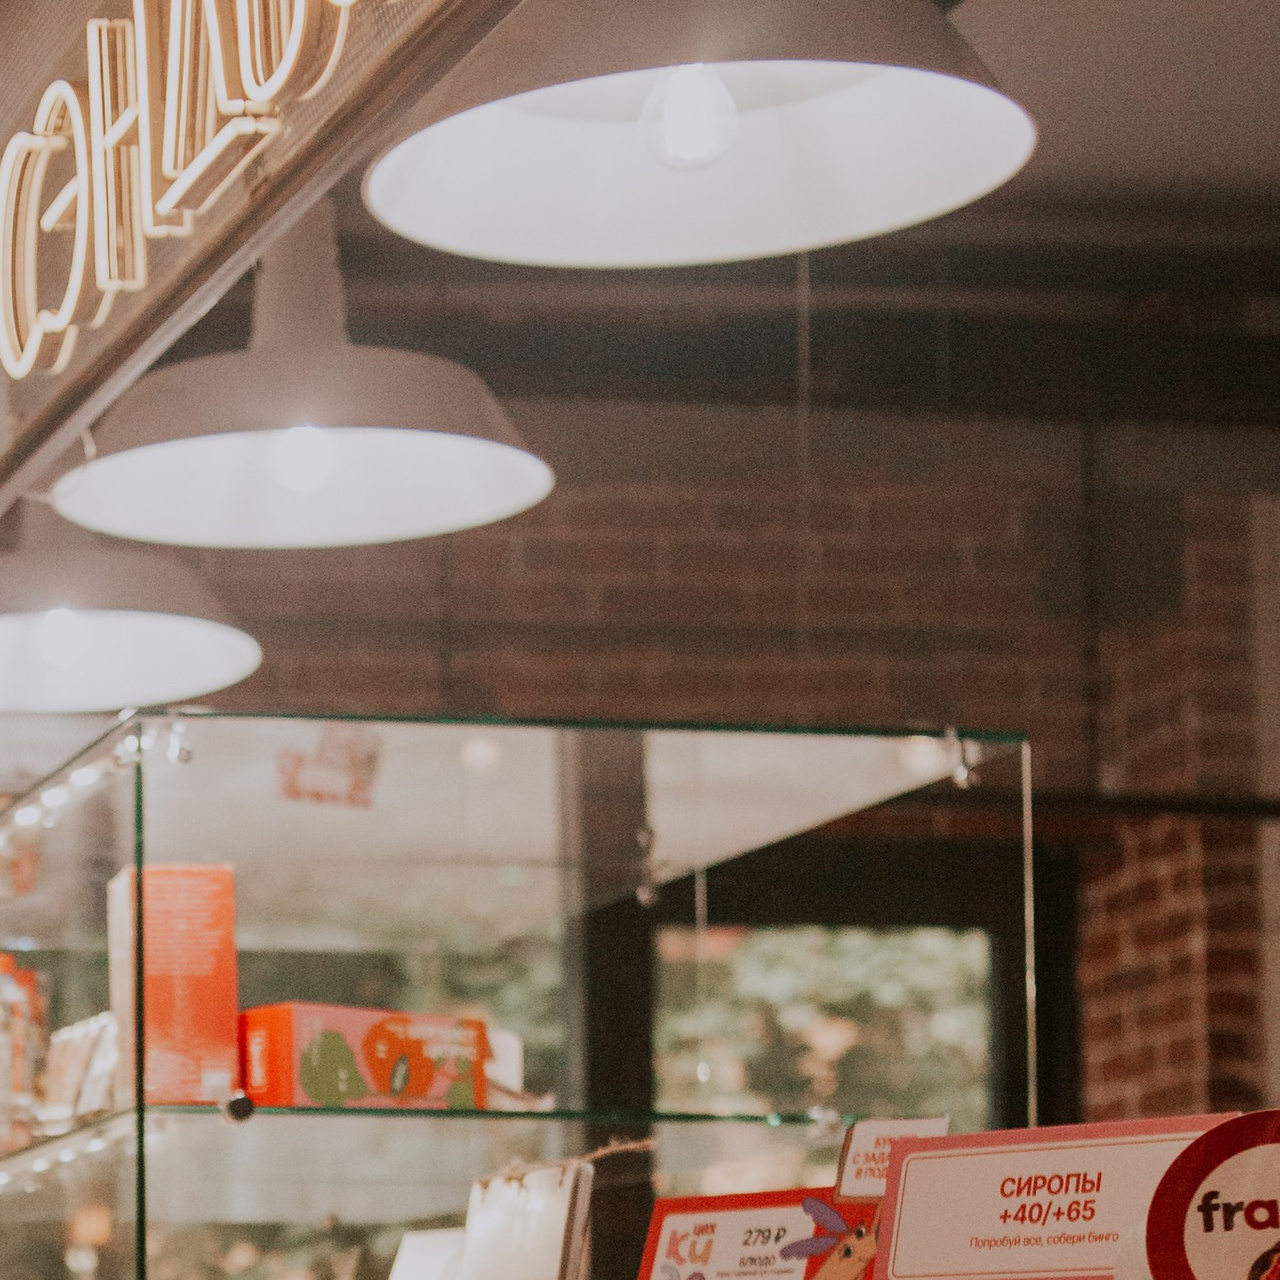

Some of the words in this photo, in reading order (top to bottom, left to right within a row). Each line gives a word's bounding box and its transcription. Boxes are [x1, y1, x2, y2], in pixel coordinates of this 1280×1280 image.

[1000, 1172, 1102, 1198] СИРОПЫ
[999, 1200, 1095, 1226] +40/+65
[742, 1227, 770, 1247] 279
[970, 1235, 1020, 1250] Попробуй
[1047, 1234, 1085, 1246] собери
[1087, 1231, 1119, 1243] бинго
[738, 1255, 776, 1269] БЛЮДО
